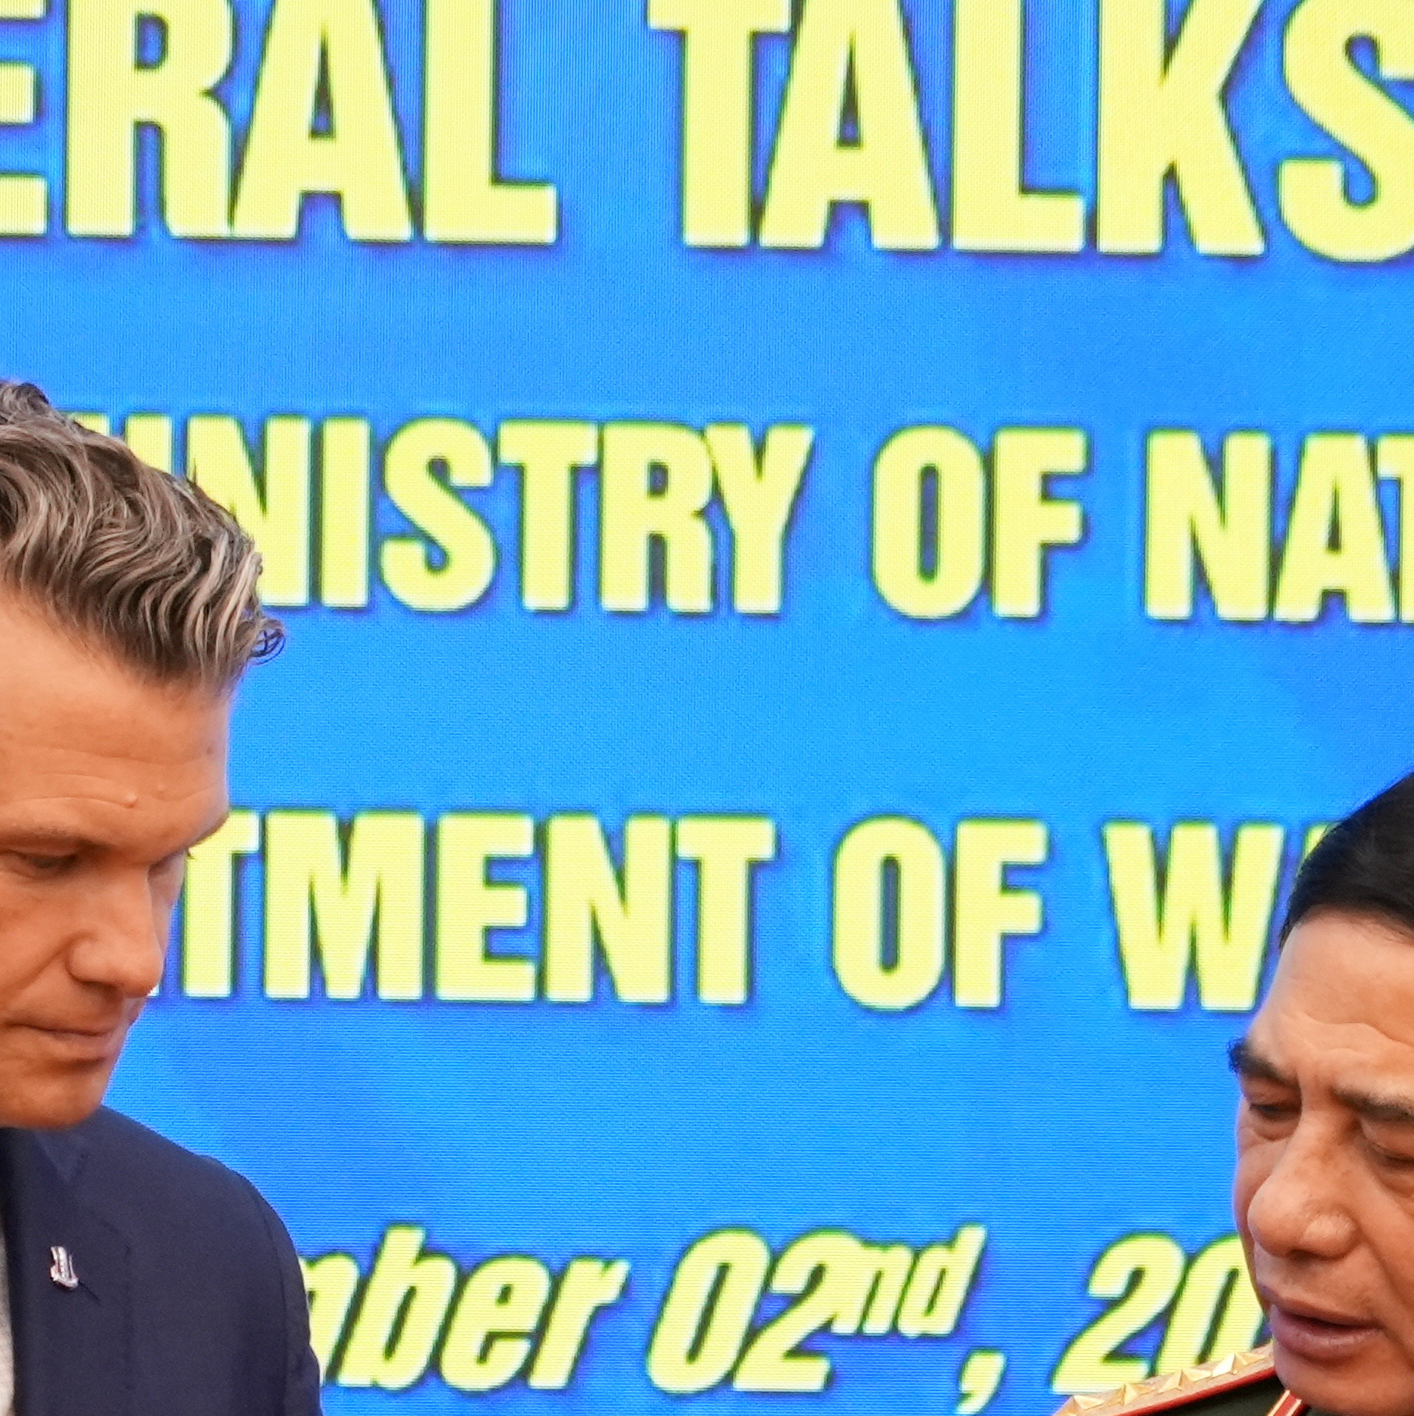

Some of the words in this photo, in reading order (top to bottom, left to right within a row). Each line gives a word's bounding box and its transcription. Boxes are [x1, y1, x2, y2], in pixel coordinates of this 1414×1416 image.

[67, 409, 812, 619] NISTRY
[871, 424, 1088, 621] OF
[832, 816, 1047, 1009] OF
[646, 1226, 1005, 1415] 02nd,
